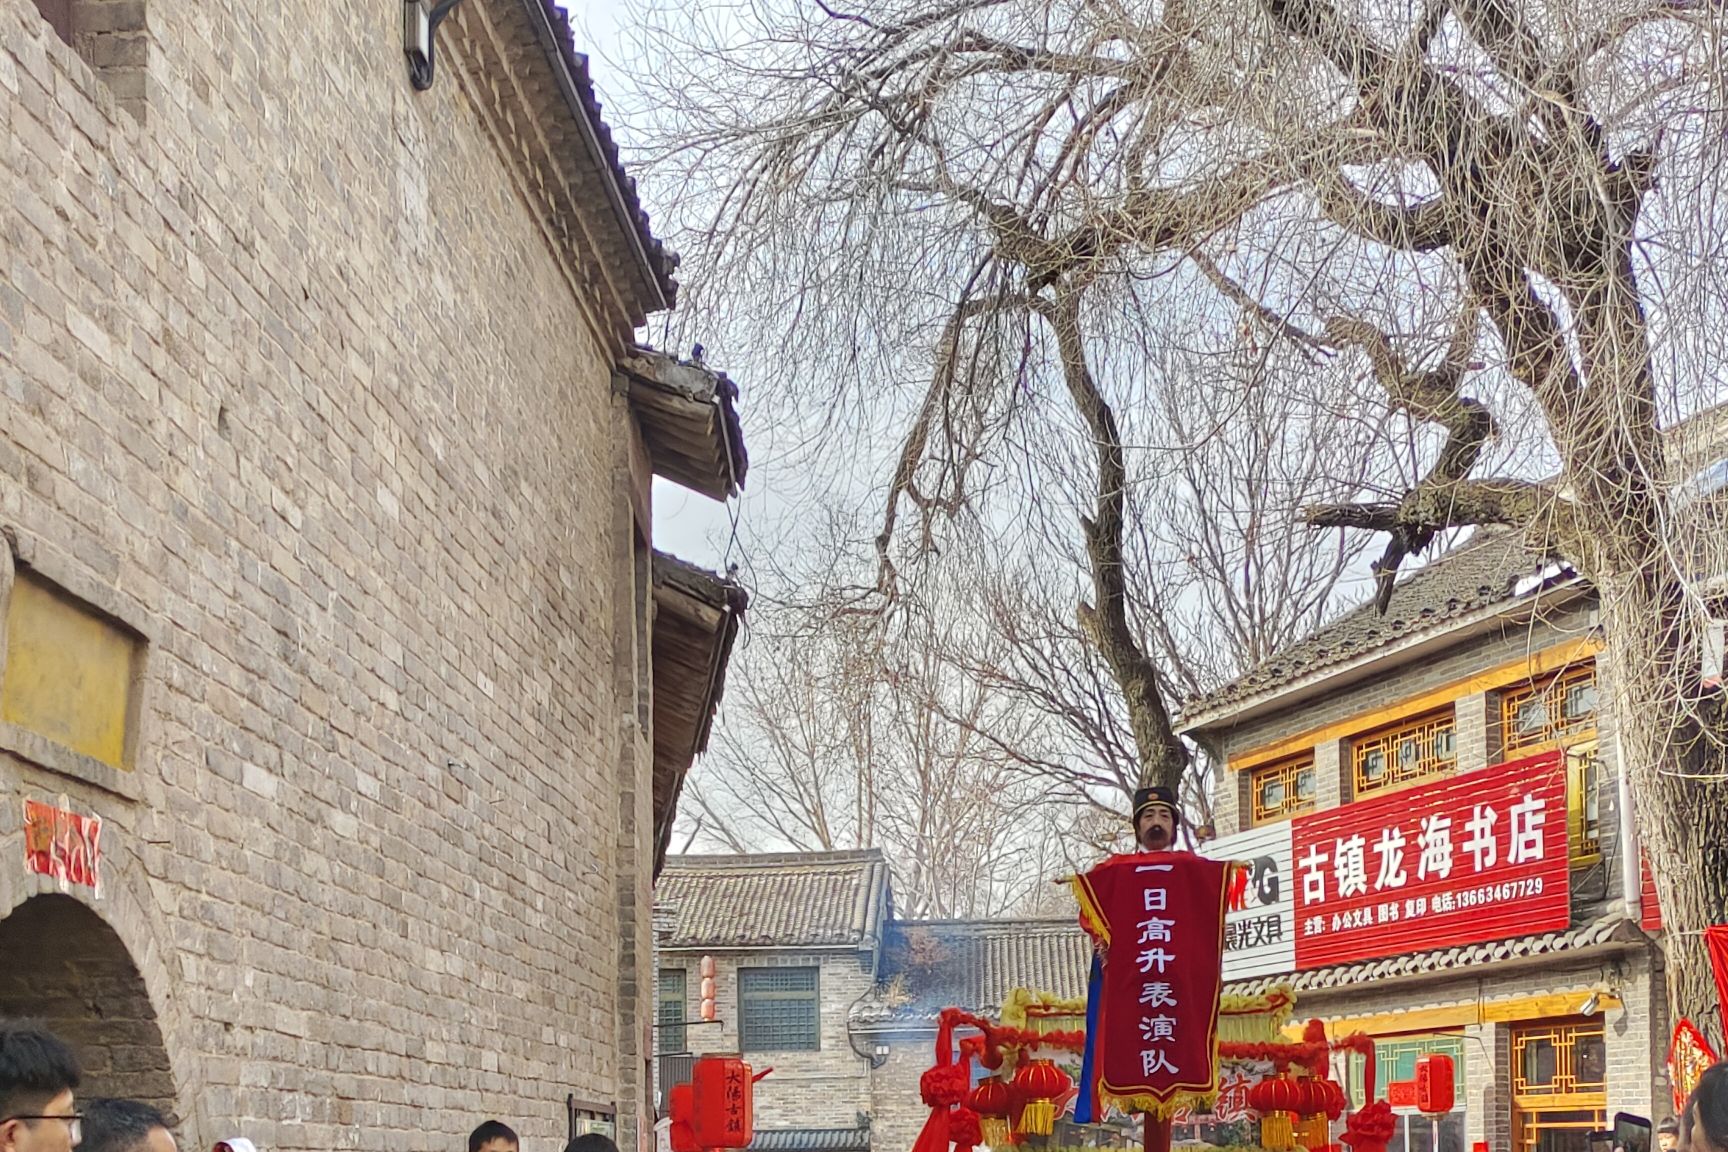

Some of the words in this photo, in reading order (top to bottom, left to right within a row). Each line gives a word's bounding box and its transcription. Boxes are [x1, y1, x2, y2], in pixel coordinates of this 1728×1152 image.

[1299, 795, 1546, 905] 古镇龙海书店
[1332, 907, 1373, 931] 办公文具
[1378, 902, 1399, 924] 图书
[1405, 897, 1427, 918] 复印
[1134, 863, 1180, 1077] 一日高升表演队
